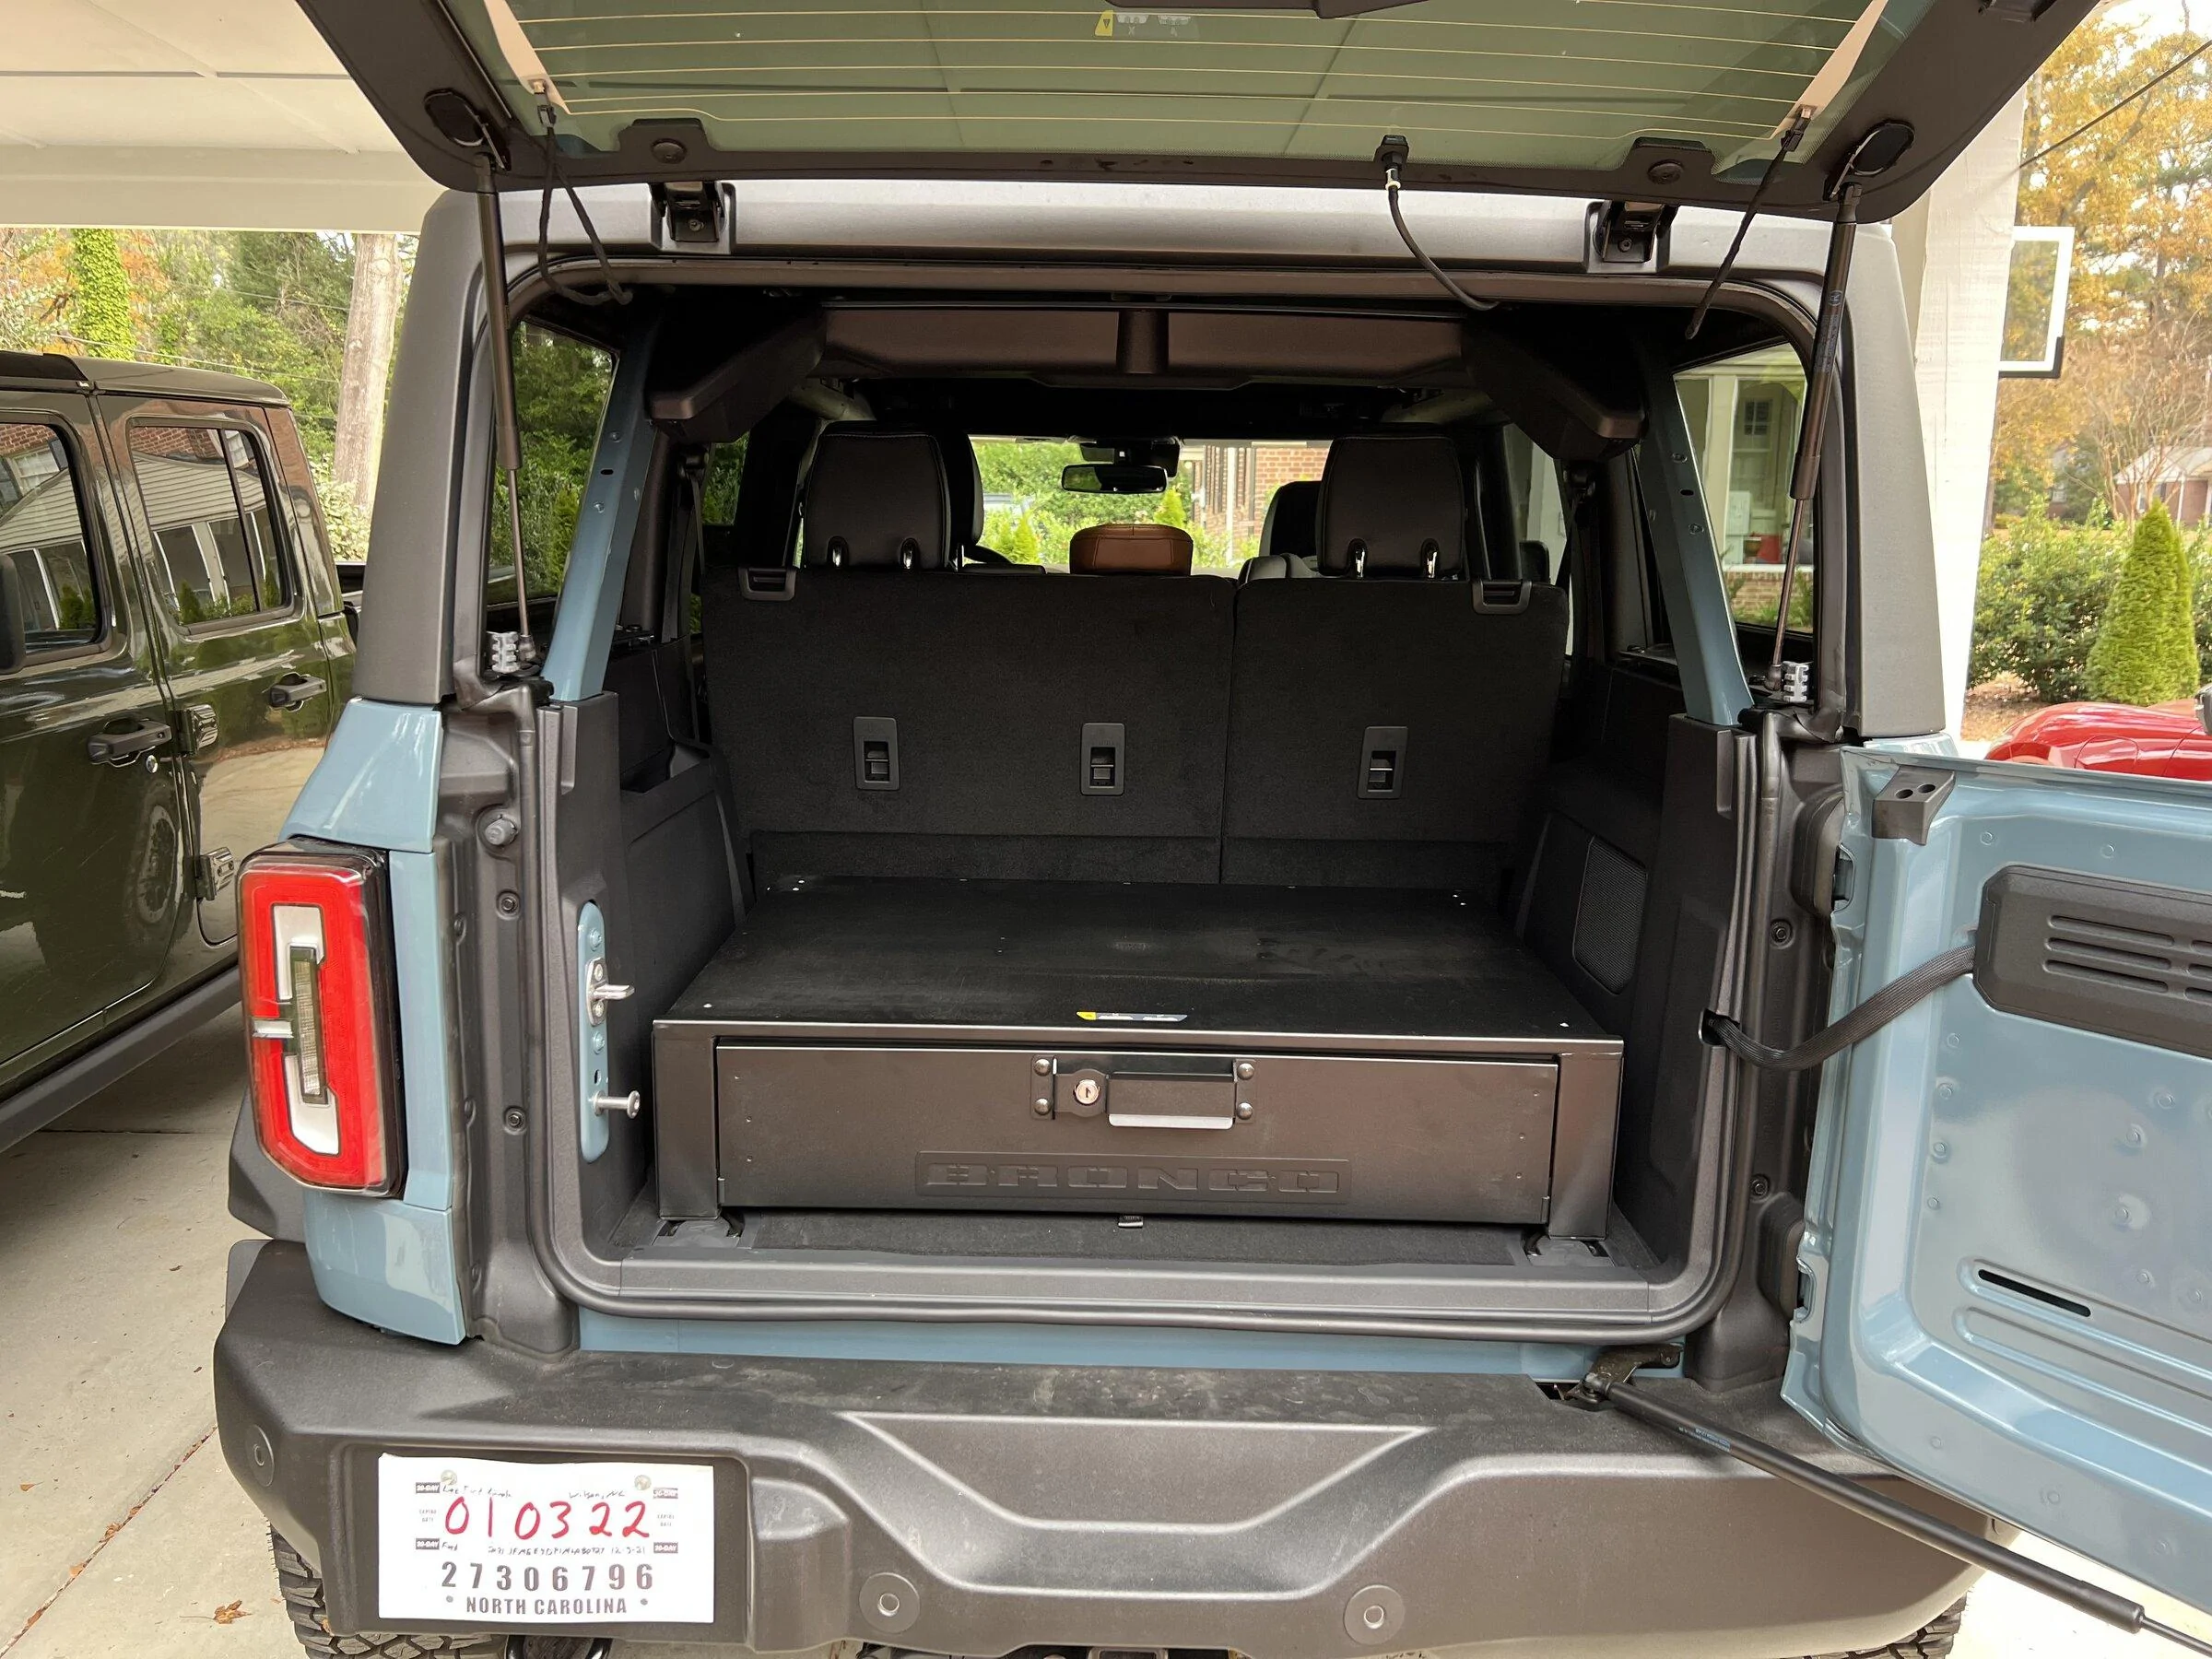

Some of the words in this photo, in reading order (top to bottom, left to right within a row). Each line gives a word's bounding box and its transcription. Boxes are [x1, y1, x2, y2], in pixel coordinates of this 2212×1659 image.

[925, 1162, 1340, 1194] BRONCO
[441, 1561, 653, 1591] 27306796
[466, 1596, 526, 1614] NORTH
[534, 1597, 627, 1615] CAROLINA
